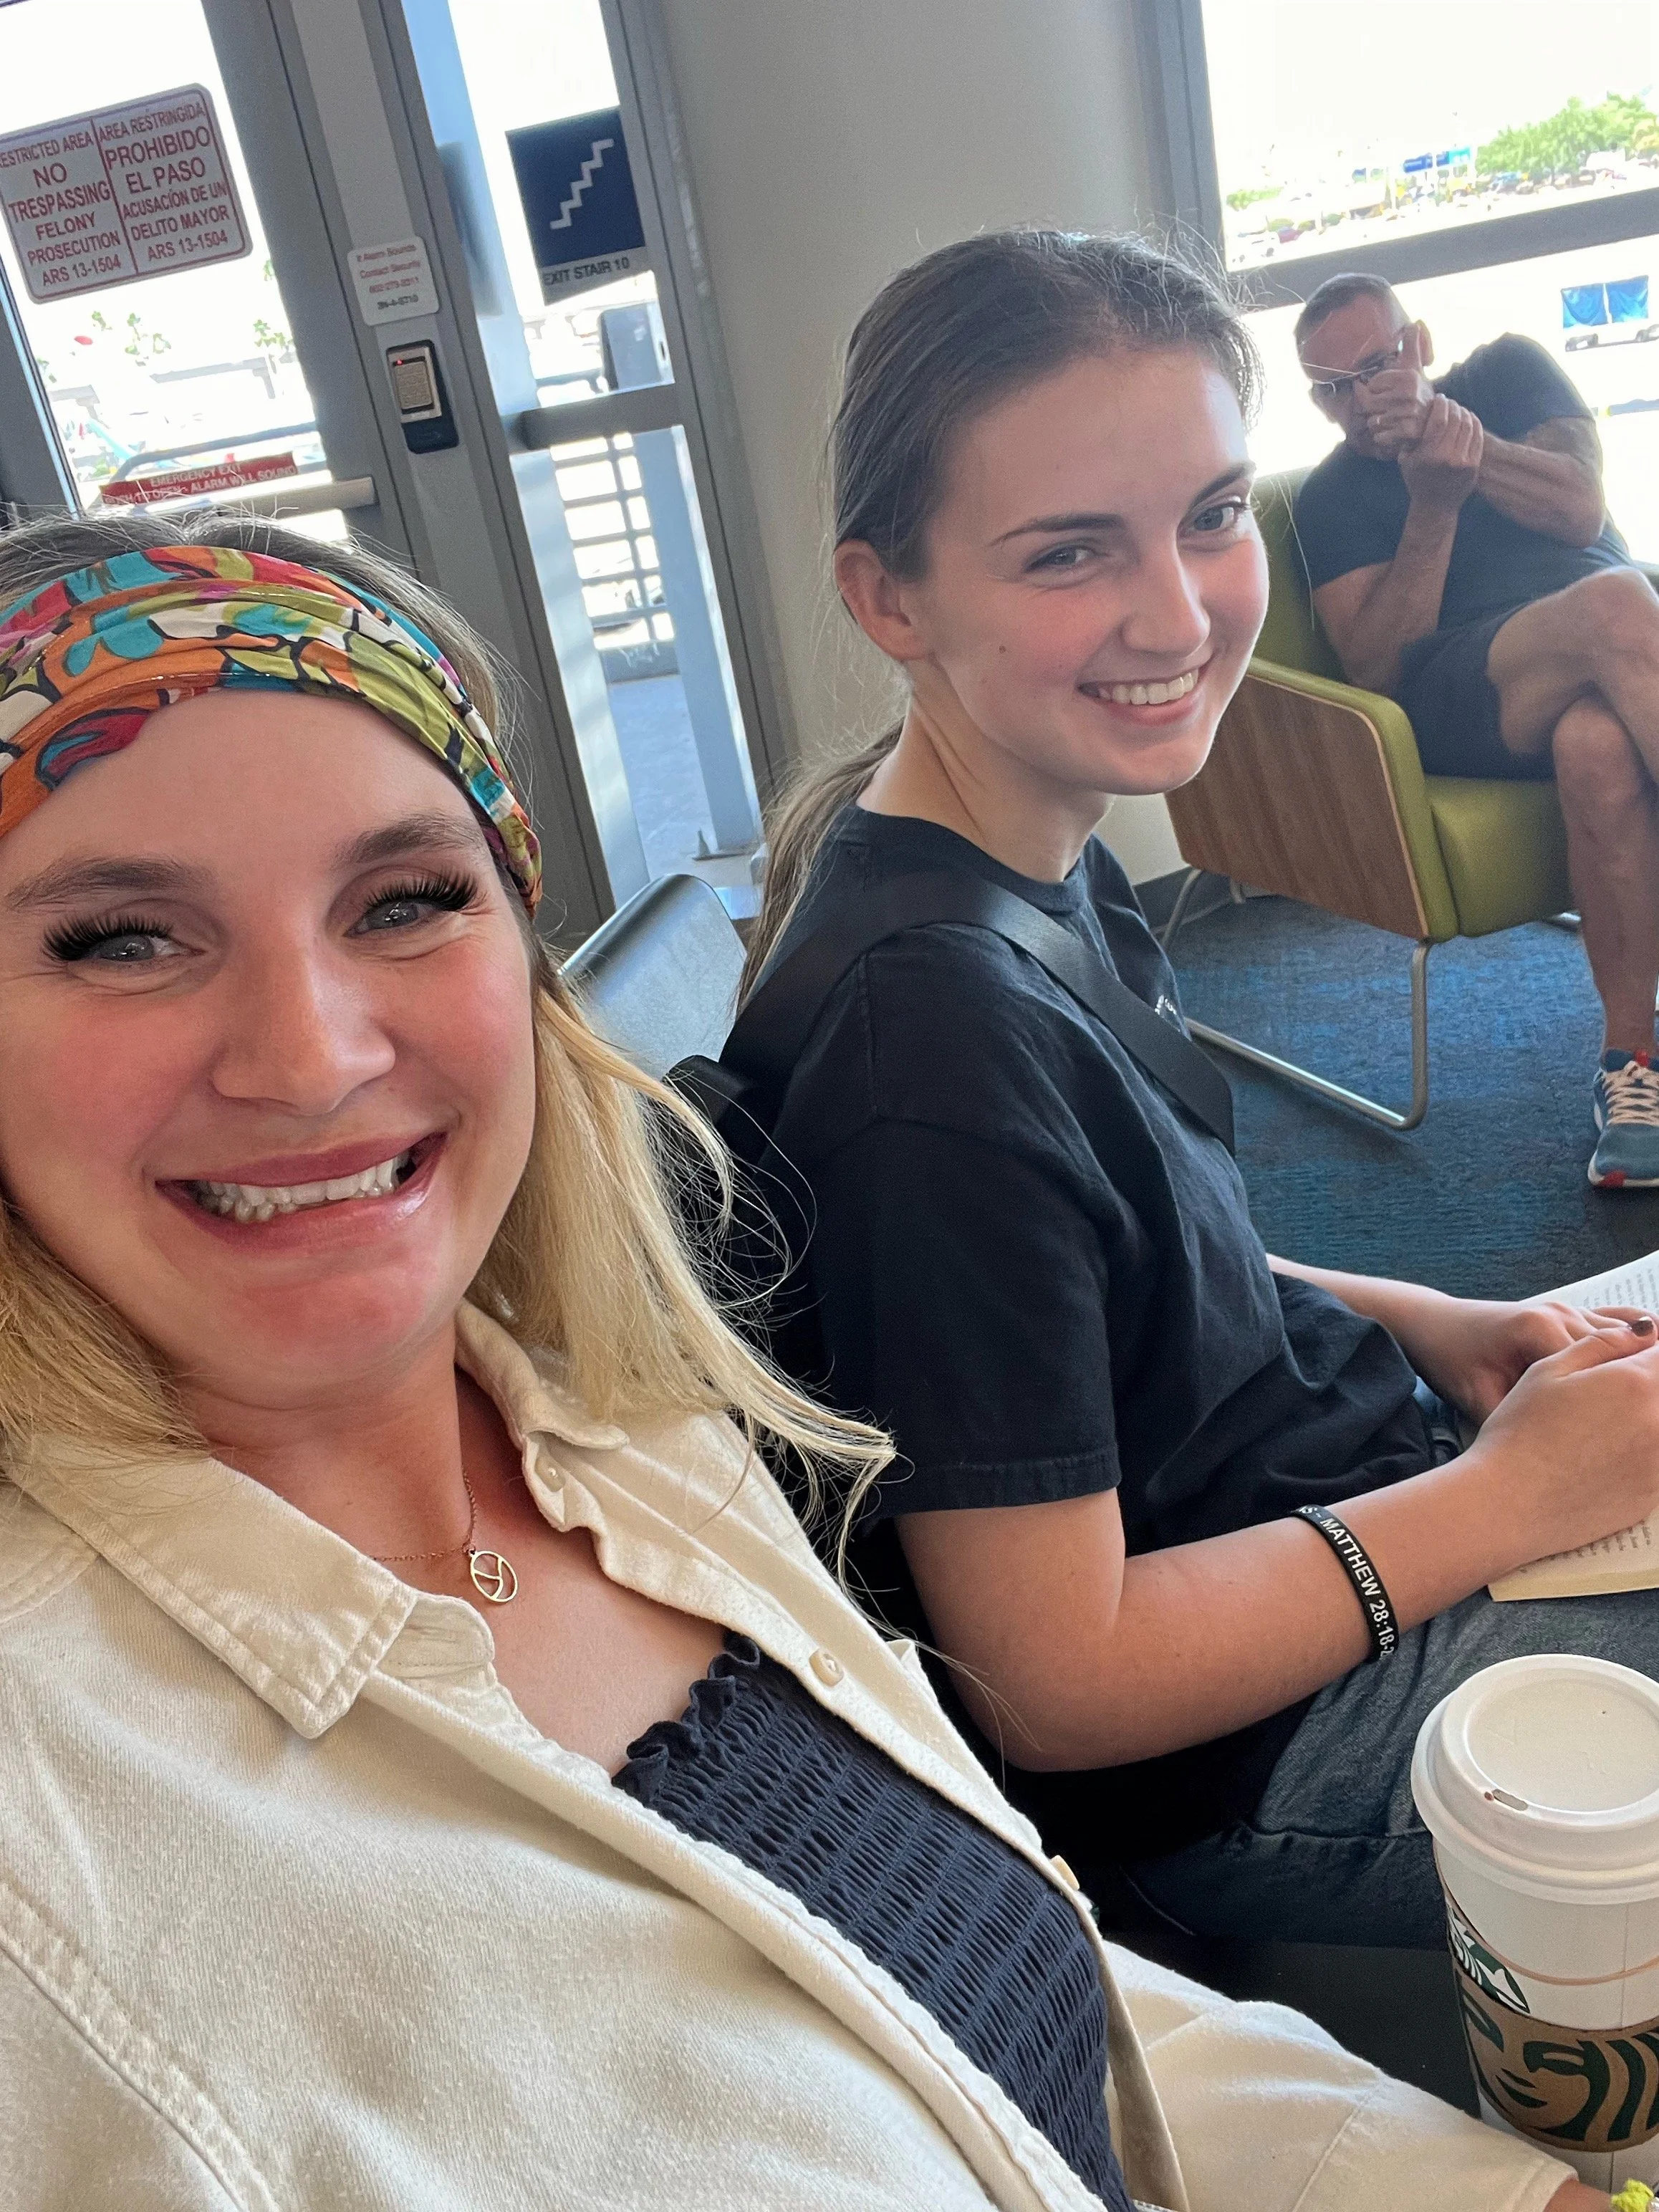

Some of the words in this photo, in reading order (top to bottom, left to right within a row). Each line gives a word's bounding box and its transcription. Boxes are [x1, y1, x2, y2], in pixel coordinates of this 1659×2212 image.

[99, 121, 130, 143] AREA
[129, 102, 206, 135] RESTRINGIDA
[0, 140, 60, 168] ESTRICTED
[62, 131, 94, 153] AREA
[105, 125, 211, 170] PROHIBIDO
[32, 162, 67, 189] NO
[125, 171, 153, 195] EL
[152, 156, 206, 188] PASO
[190, 184, 209, 203] DE
[208, 181, 228, 199] UN
[8, 180, 111, 223] TRESPASSING
[36, 211, 95, 241] FELONY
[130, 216, 178, 242] DELITO
[180, 205, 230, 230] MAYOR
[27, 230, 121, 266] PROSECUTION
[148, 241, 176, 262] ARS
[178, 229, 229, 254] 13-1504
[43, 266, 70, 287] ARS
[72, 254, 122, 278] 13-1504
[544, 269, 571, 287] EXIT
[573, 261, 612, 280] STAIR
[614, 256, 630, 271] 10
[150, 466, 216, 488] EMERGENCY
[216, 461, 242, 476] EXIT
[191, 476, 229, 494] ALARM
[1319, 1517, 1382, 1597] MATTHEW
